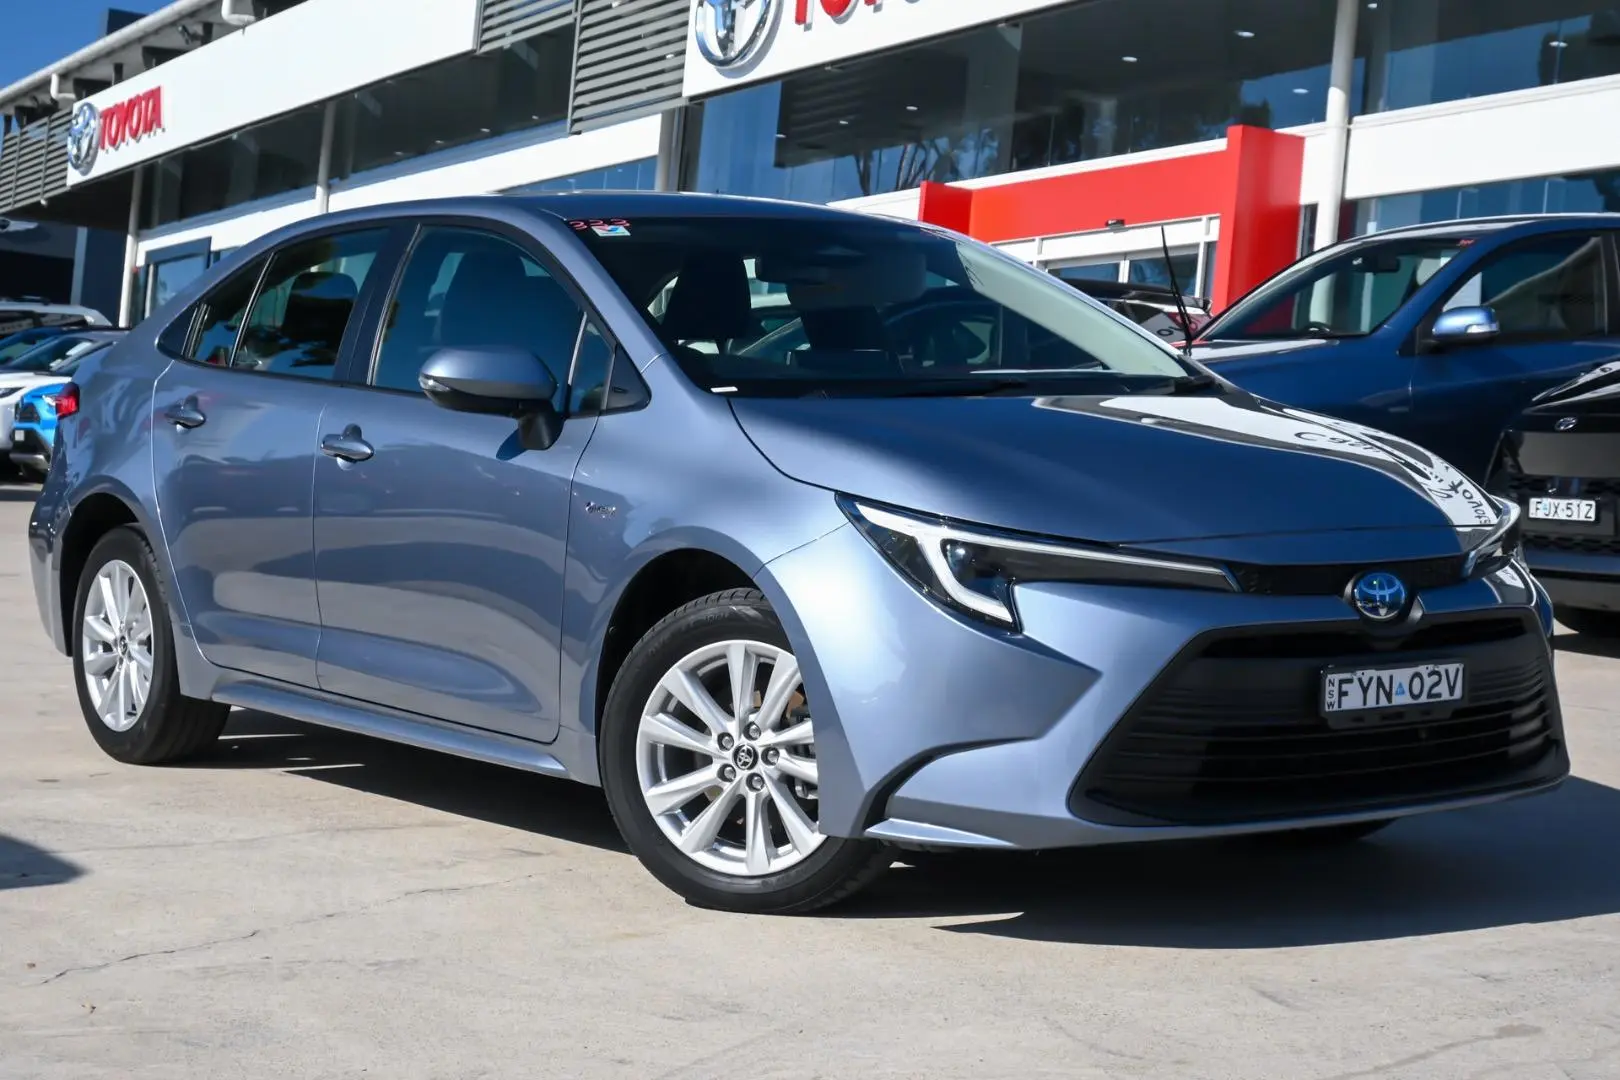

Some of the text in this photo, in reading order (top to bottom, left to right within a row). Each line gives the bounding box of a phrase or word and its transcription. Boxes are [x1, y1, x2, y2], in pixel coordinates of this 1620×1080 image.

[100, 86, 161, 150] TOYOTA
[1326, 678, 1336, 710] NSW
[1338, 667, 1460, 709] FYN 02V
